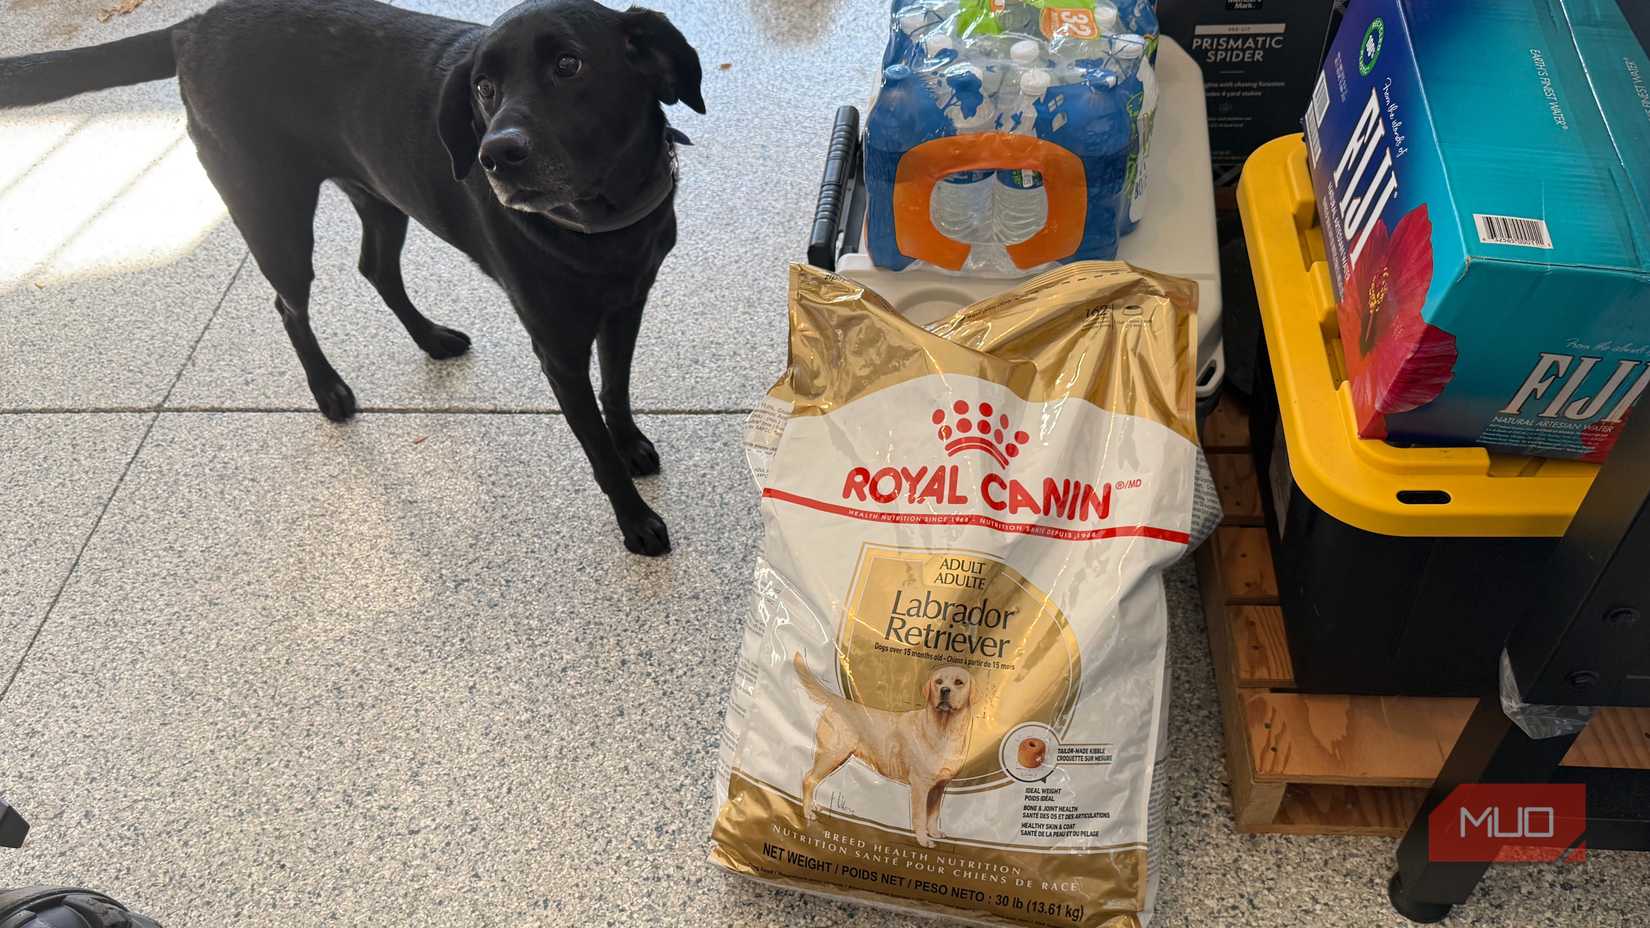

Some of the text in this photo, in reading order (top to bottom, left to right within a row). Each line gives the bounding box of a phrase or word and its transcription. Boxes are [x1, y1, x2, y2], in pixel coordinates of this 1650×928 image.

[1191, 36, 1284, 50] PRISMATIC
[1206, 50, 1264, 62] SPIDER
[1388, 103, 1398, 119] the
[1333, 86, 1398, 272] FIJI
[1499, 352, 1650, 423] FIJI
[1491, 416, 1615, 433] NATURAL ARTESIAN WATER
[841, 464, 968, 505] ROYAL
[980, 473, 1112, 521] CANIN
[848, 510, 878, 520] HEALTH
[881, 514, 921, 522] NUTRITION
[1046, 529, 1072, 539] DEPUIS
[934, 573, 986, 590] ADULTE
[939, 557, 986, 574] ADULT
[891, 590, 1015, 629] Labrador
[884, 616, 1010, 658] Retriever
[874, 642, 889, 653] Dogs
[889, 646, 902, 654] over
[903, 648, 911, 656] 15
[911, 650, 933, 660] months
[933, 653, 943, 661] old
[992, 661, 1000, 669] 15
[772, 824, 848, 855] NUTRITION
[855, 850, 898, 866] SANTÉ
[906, 861, 945, 874] POUR
[953, 868, 1007, 884] CHIENS
[1015, 879, 1033, 888] DE
[824, 830, 1022, 875] BREED HEALTH NUTRITION
[763, 842, 785, 861] NET
[787, 848, 833, 873] WEIGHT
[841, 865, 878, 881] POIDS
[881, 874, 904, 887] NET
[915, 879, 948, 896] PESO
[950, 886, 985, 902] NETO
[995, 894, 1010, 907] 30
[1012, 897, 1024, 910] lb
[1027, 899, 1063, 917] (13.61
[1064, 904, 1084, 922] kg)
